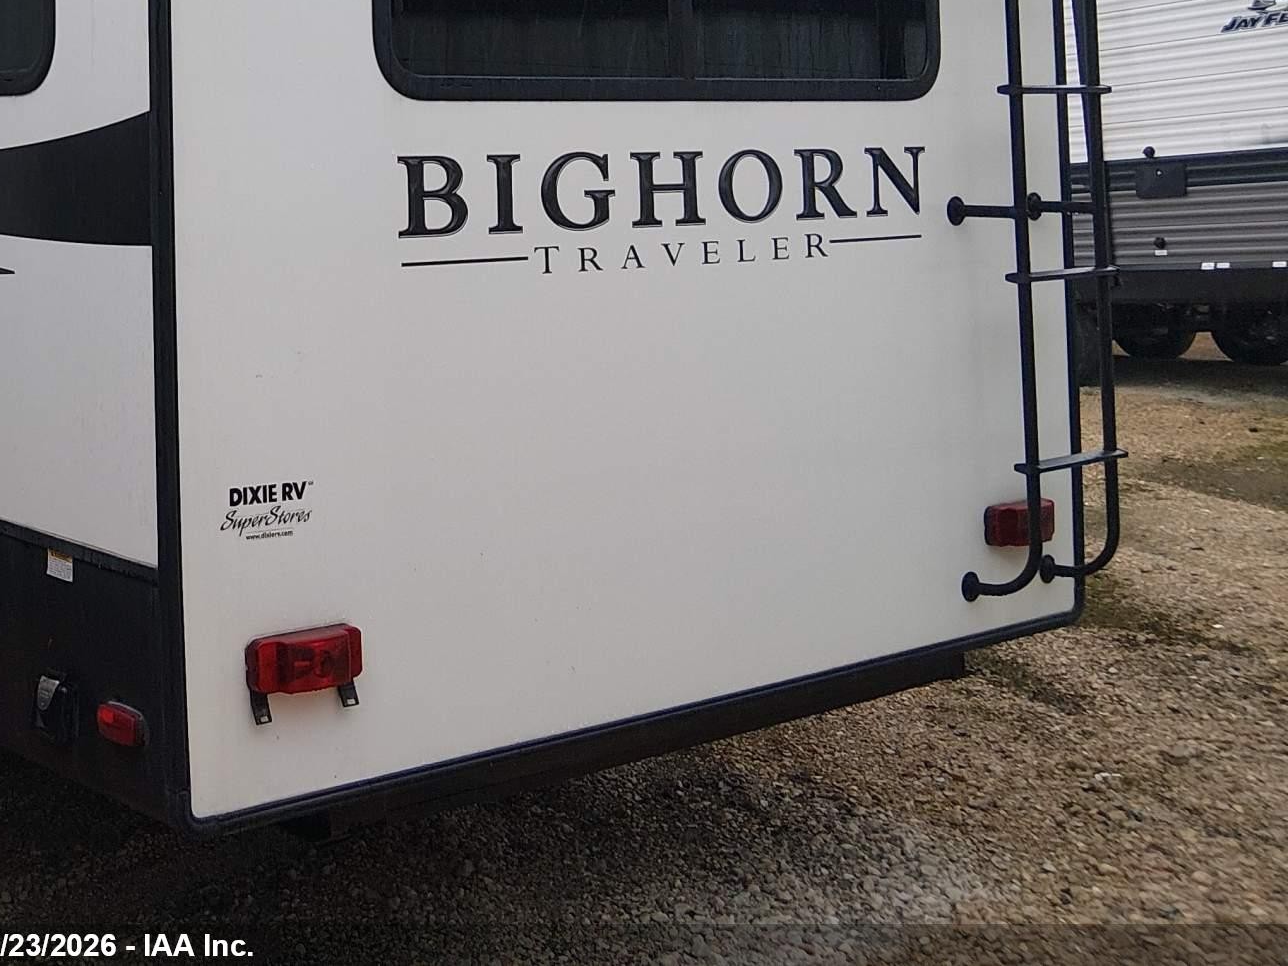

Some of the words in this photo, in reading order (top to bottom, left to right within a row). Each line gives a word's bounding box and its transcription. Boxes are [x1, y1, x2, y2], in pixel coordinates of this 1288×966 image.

[1220, 15, 1262, 33] JAY
[396, 146, 926, 239] BIGHORN
[534, 233, 830, 275] TRAVELER
[229, 484, 278, 507] DIXIE
[281, 480, 307, 502] RV
[220, 505, 312, 537] SuperStores
